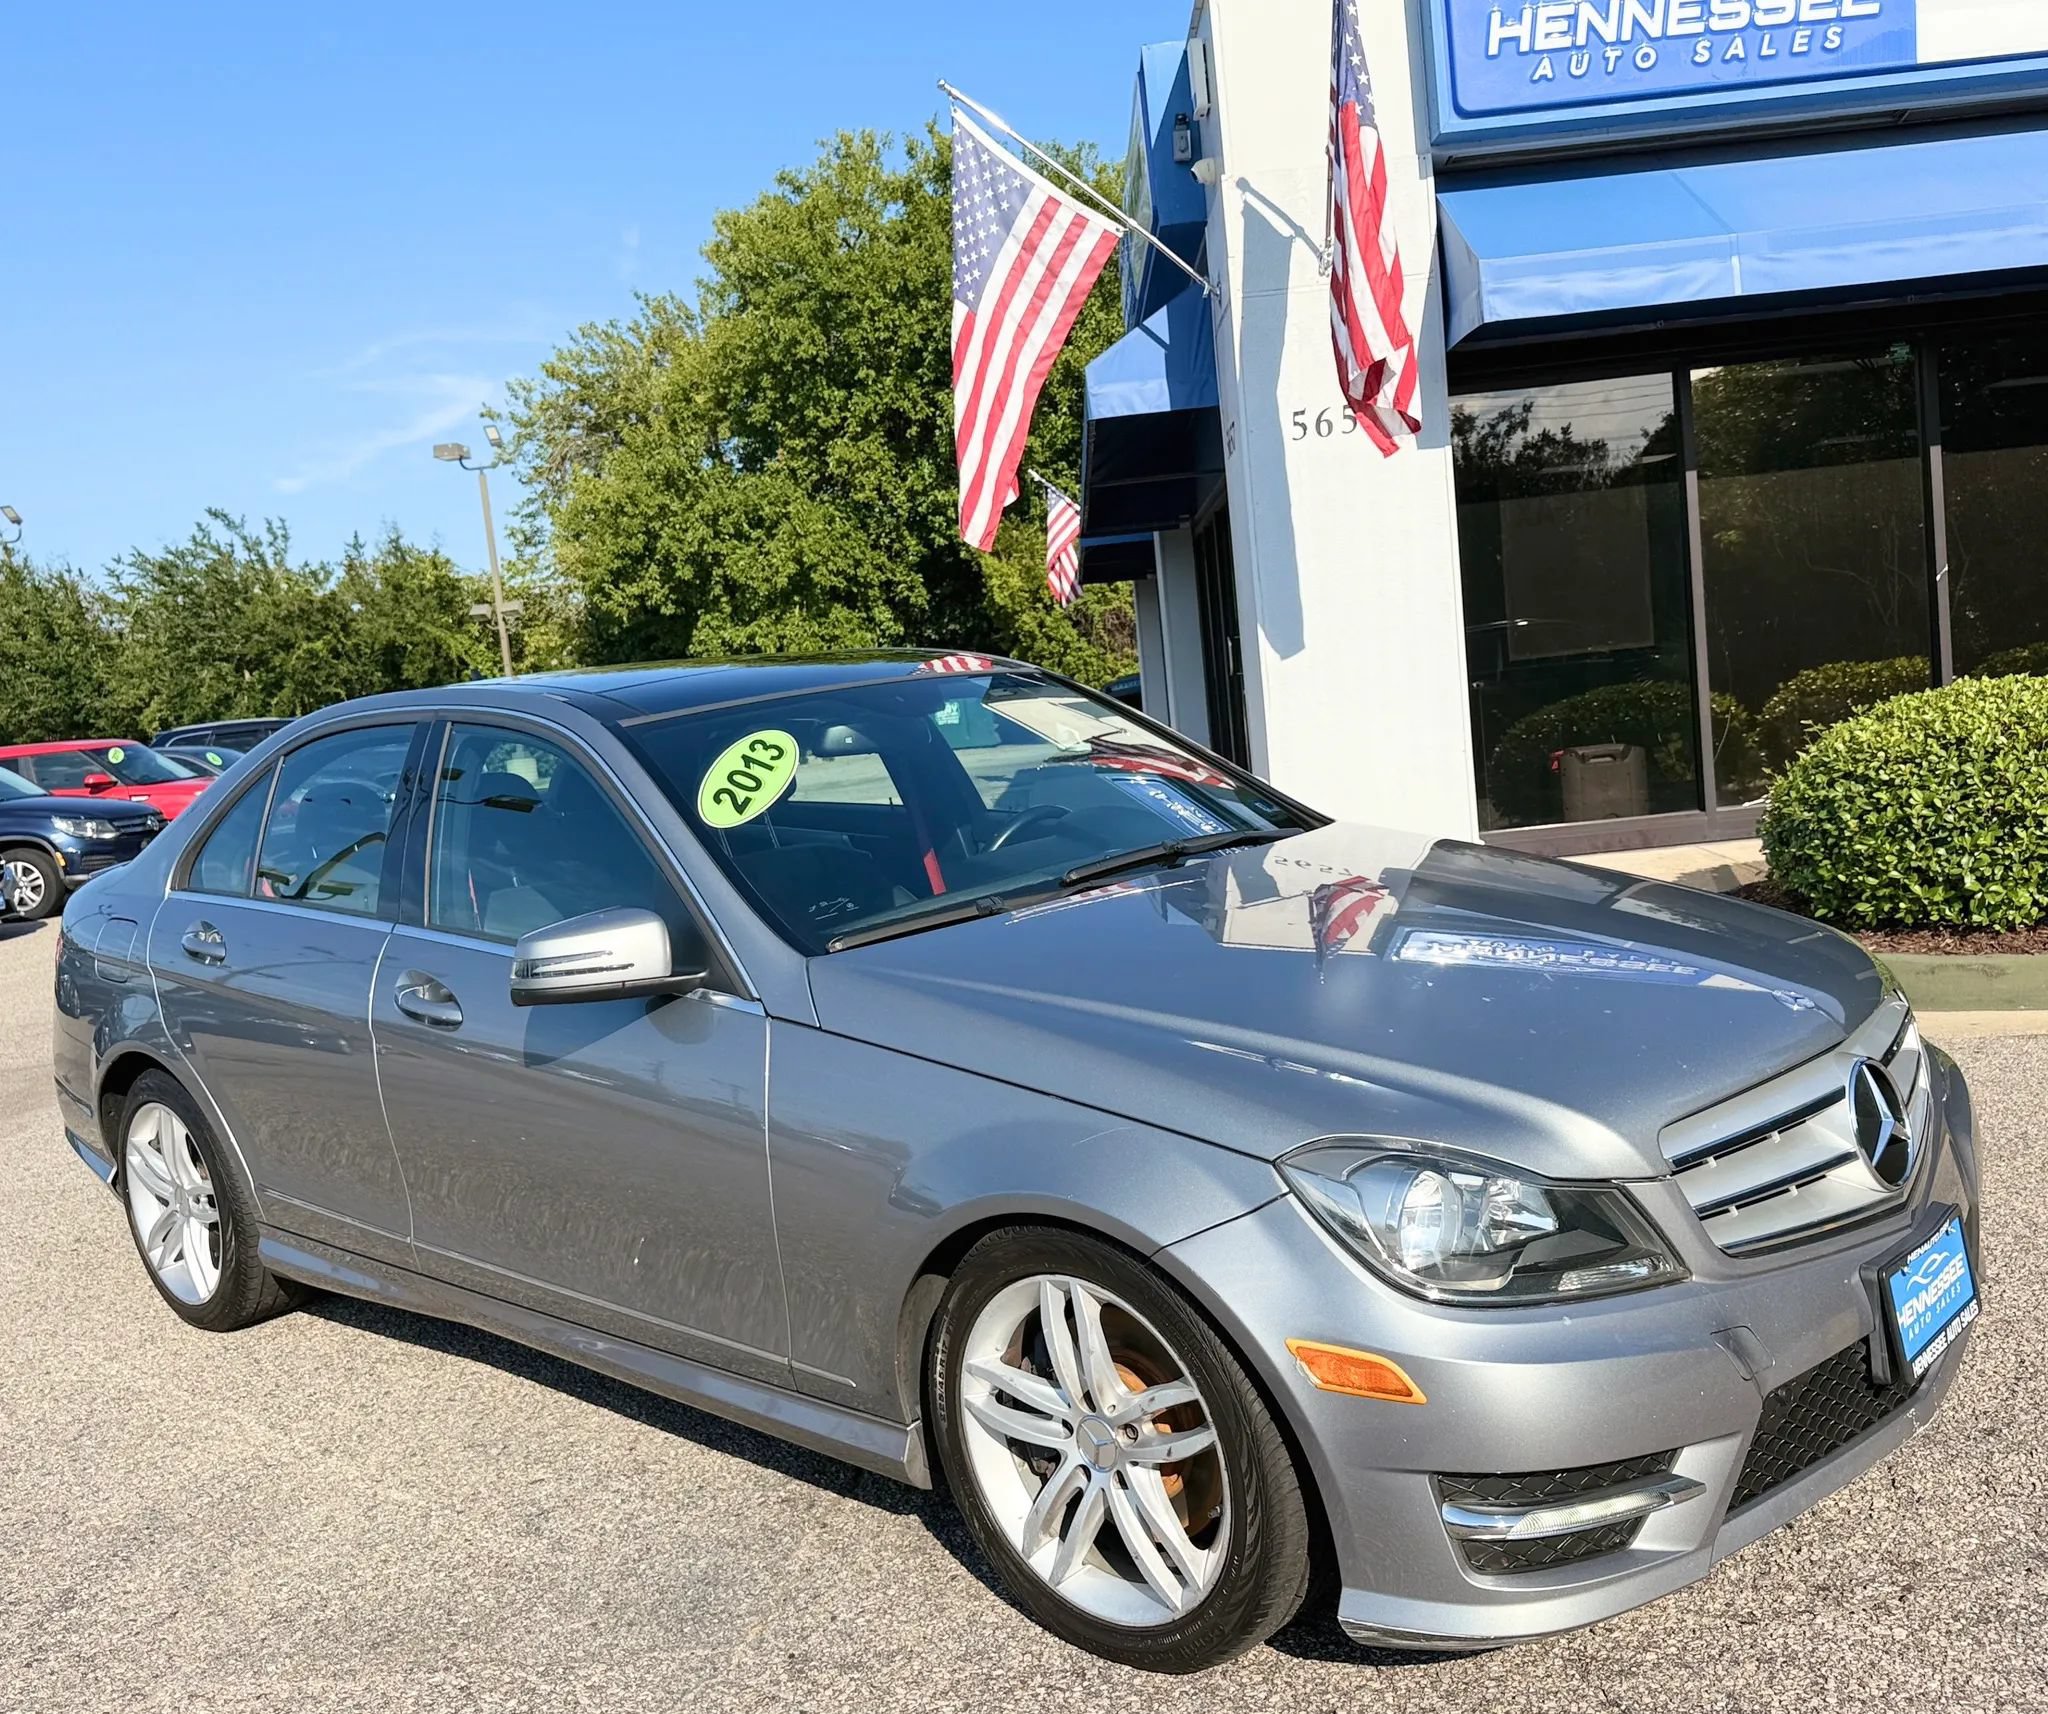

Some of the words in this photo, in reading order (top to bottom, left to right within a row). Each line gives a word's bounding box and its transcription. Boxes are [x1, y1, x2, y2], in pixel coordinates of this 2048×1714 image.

[1532, 46, 1658, 81] AUTO
[1693, 25, 1843, 63] SALES
[1291, 404, 1358, 441] 565
[713, 739, 785, 816] 2013
[1896, 1252, 1966, 1329] HENNESSEE
[1908, 1311, 1932, 1342] AUTO
[1936, 1280, 1961, 1314] SALES
[1911, 1330, 1948, 1379] HENNESSEE
[1946, 1316, 1963, 1345] AUTO
[1960, 1298, 1980, 1329] SALES
